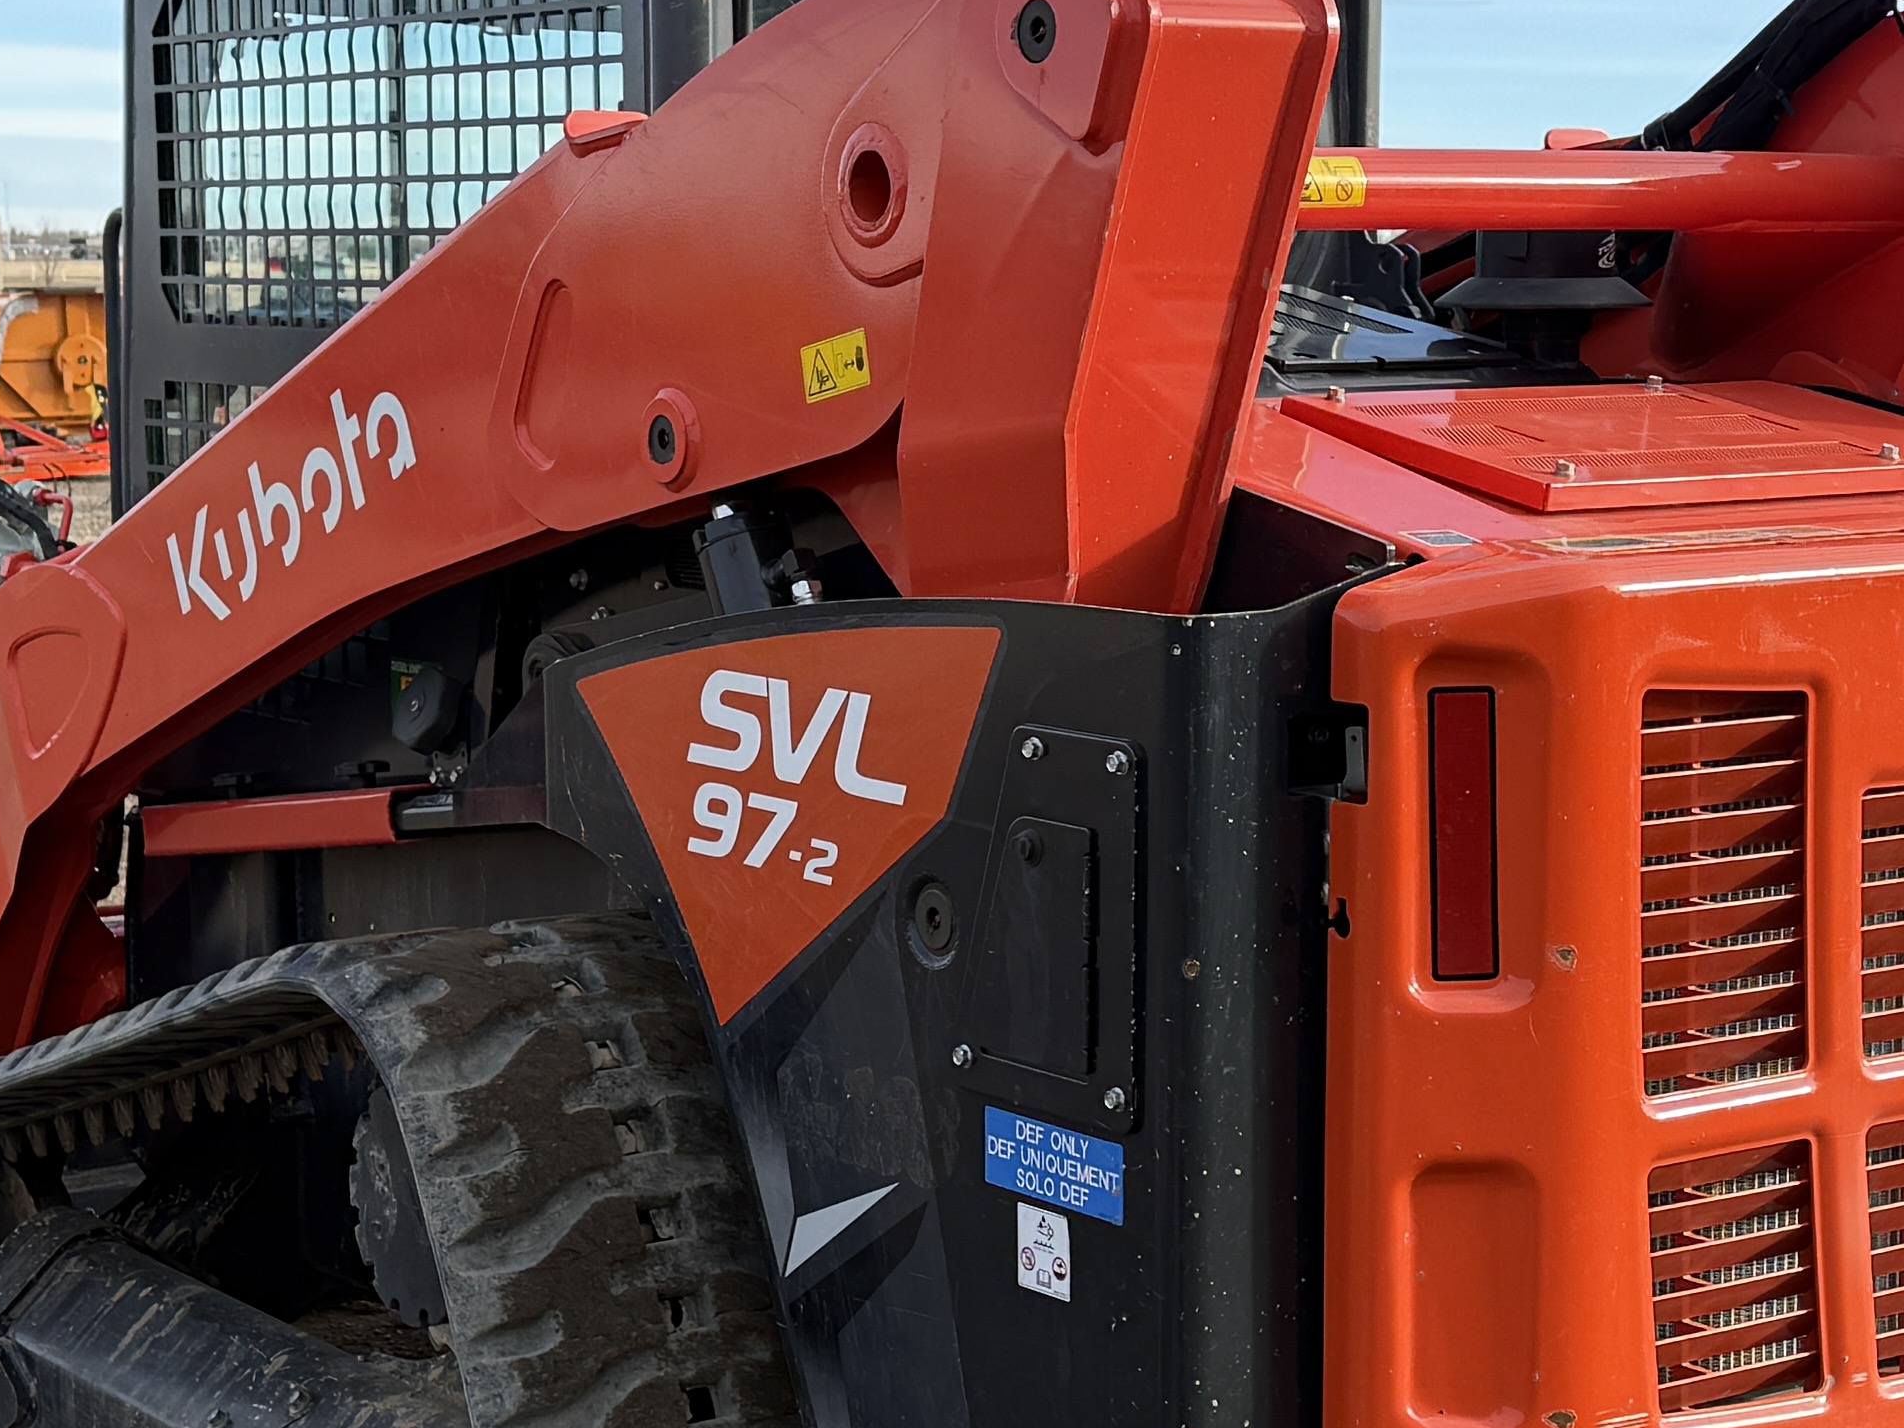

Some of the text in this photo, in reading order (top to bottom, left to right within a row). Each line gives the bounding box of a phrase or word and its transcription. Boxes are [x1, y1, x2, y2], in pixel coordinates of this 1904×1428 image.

[166, 388, 417, 621] Kubota
[687, 669, 907, 806] SVL
[987, 1134, 1119, 1194] DEF UNIQUEMENT
[1016, 1119, 1089, 1160] DEF ONLY
[1016, 1168, 1090, 1207] SOLO DEF
